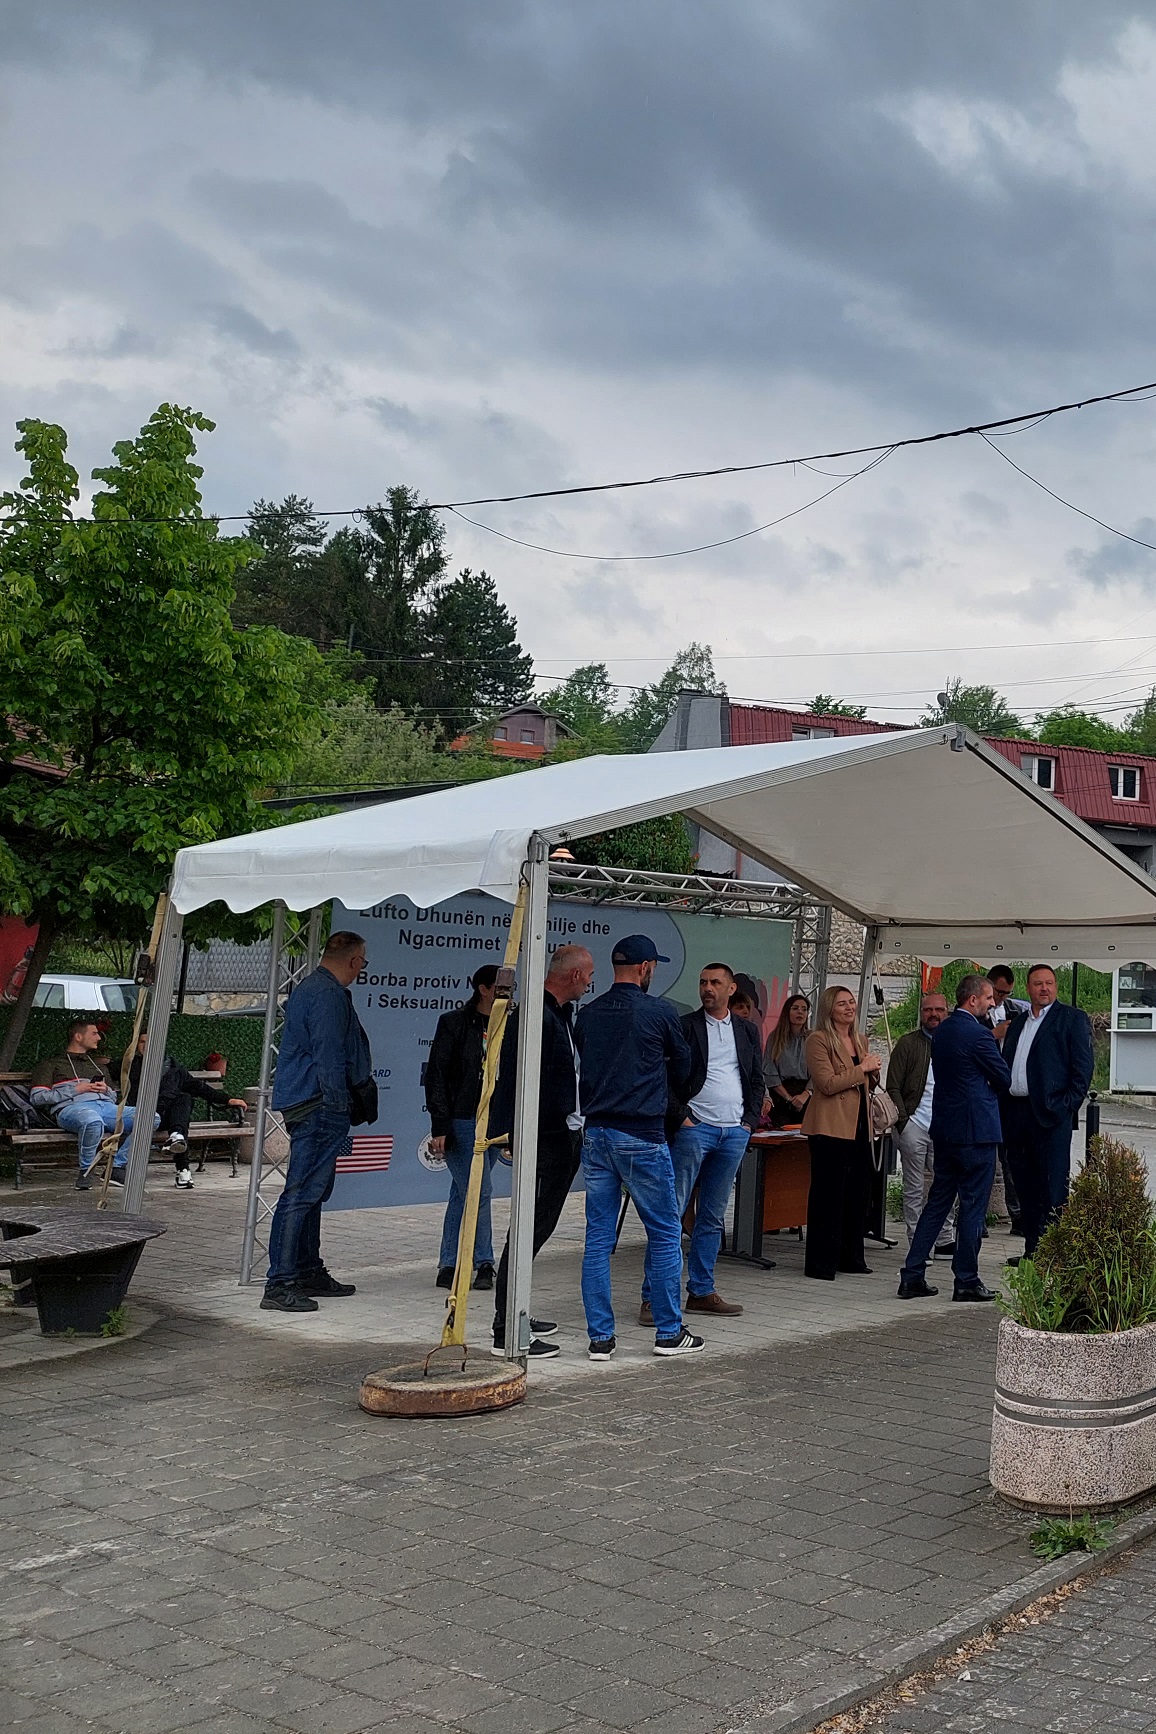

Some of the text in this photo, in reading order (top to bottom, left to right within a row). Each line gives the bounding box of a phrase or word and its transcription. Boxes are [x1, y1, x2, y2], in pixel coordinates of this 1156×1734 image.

[416, 906, 485, 926] Dhunën
[491, 913, 512, 928] në
[547, 917, 577, 936] ilje
[582, 920, 611, 935] dhe
[398, 928, 501, 951] Ngacmimet
[356, 971, 408, 987] Borba
[413, 975, 461, 990] protiv
[367, 993, 465, 1010] i Seksualno
[372, 1069, 391, 1078] ARD
